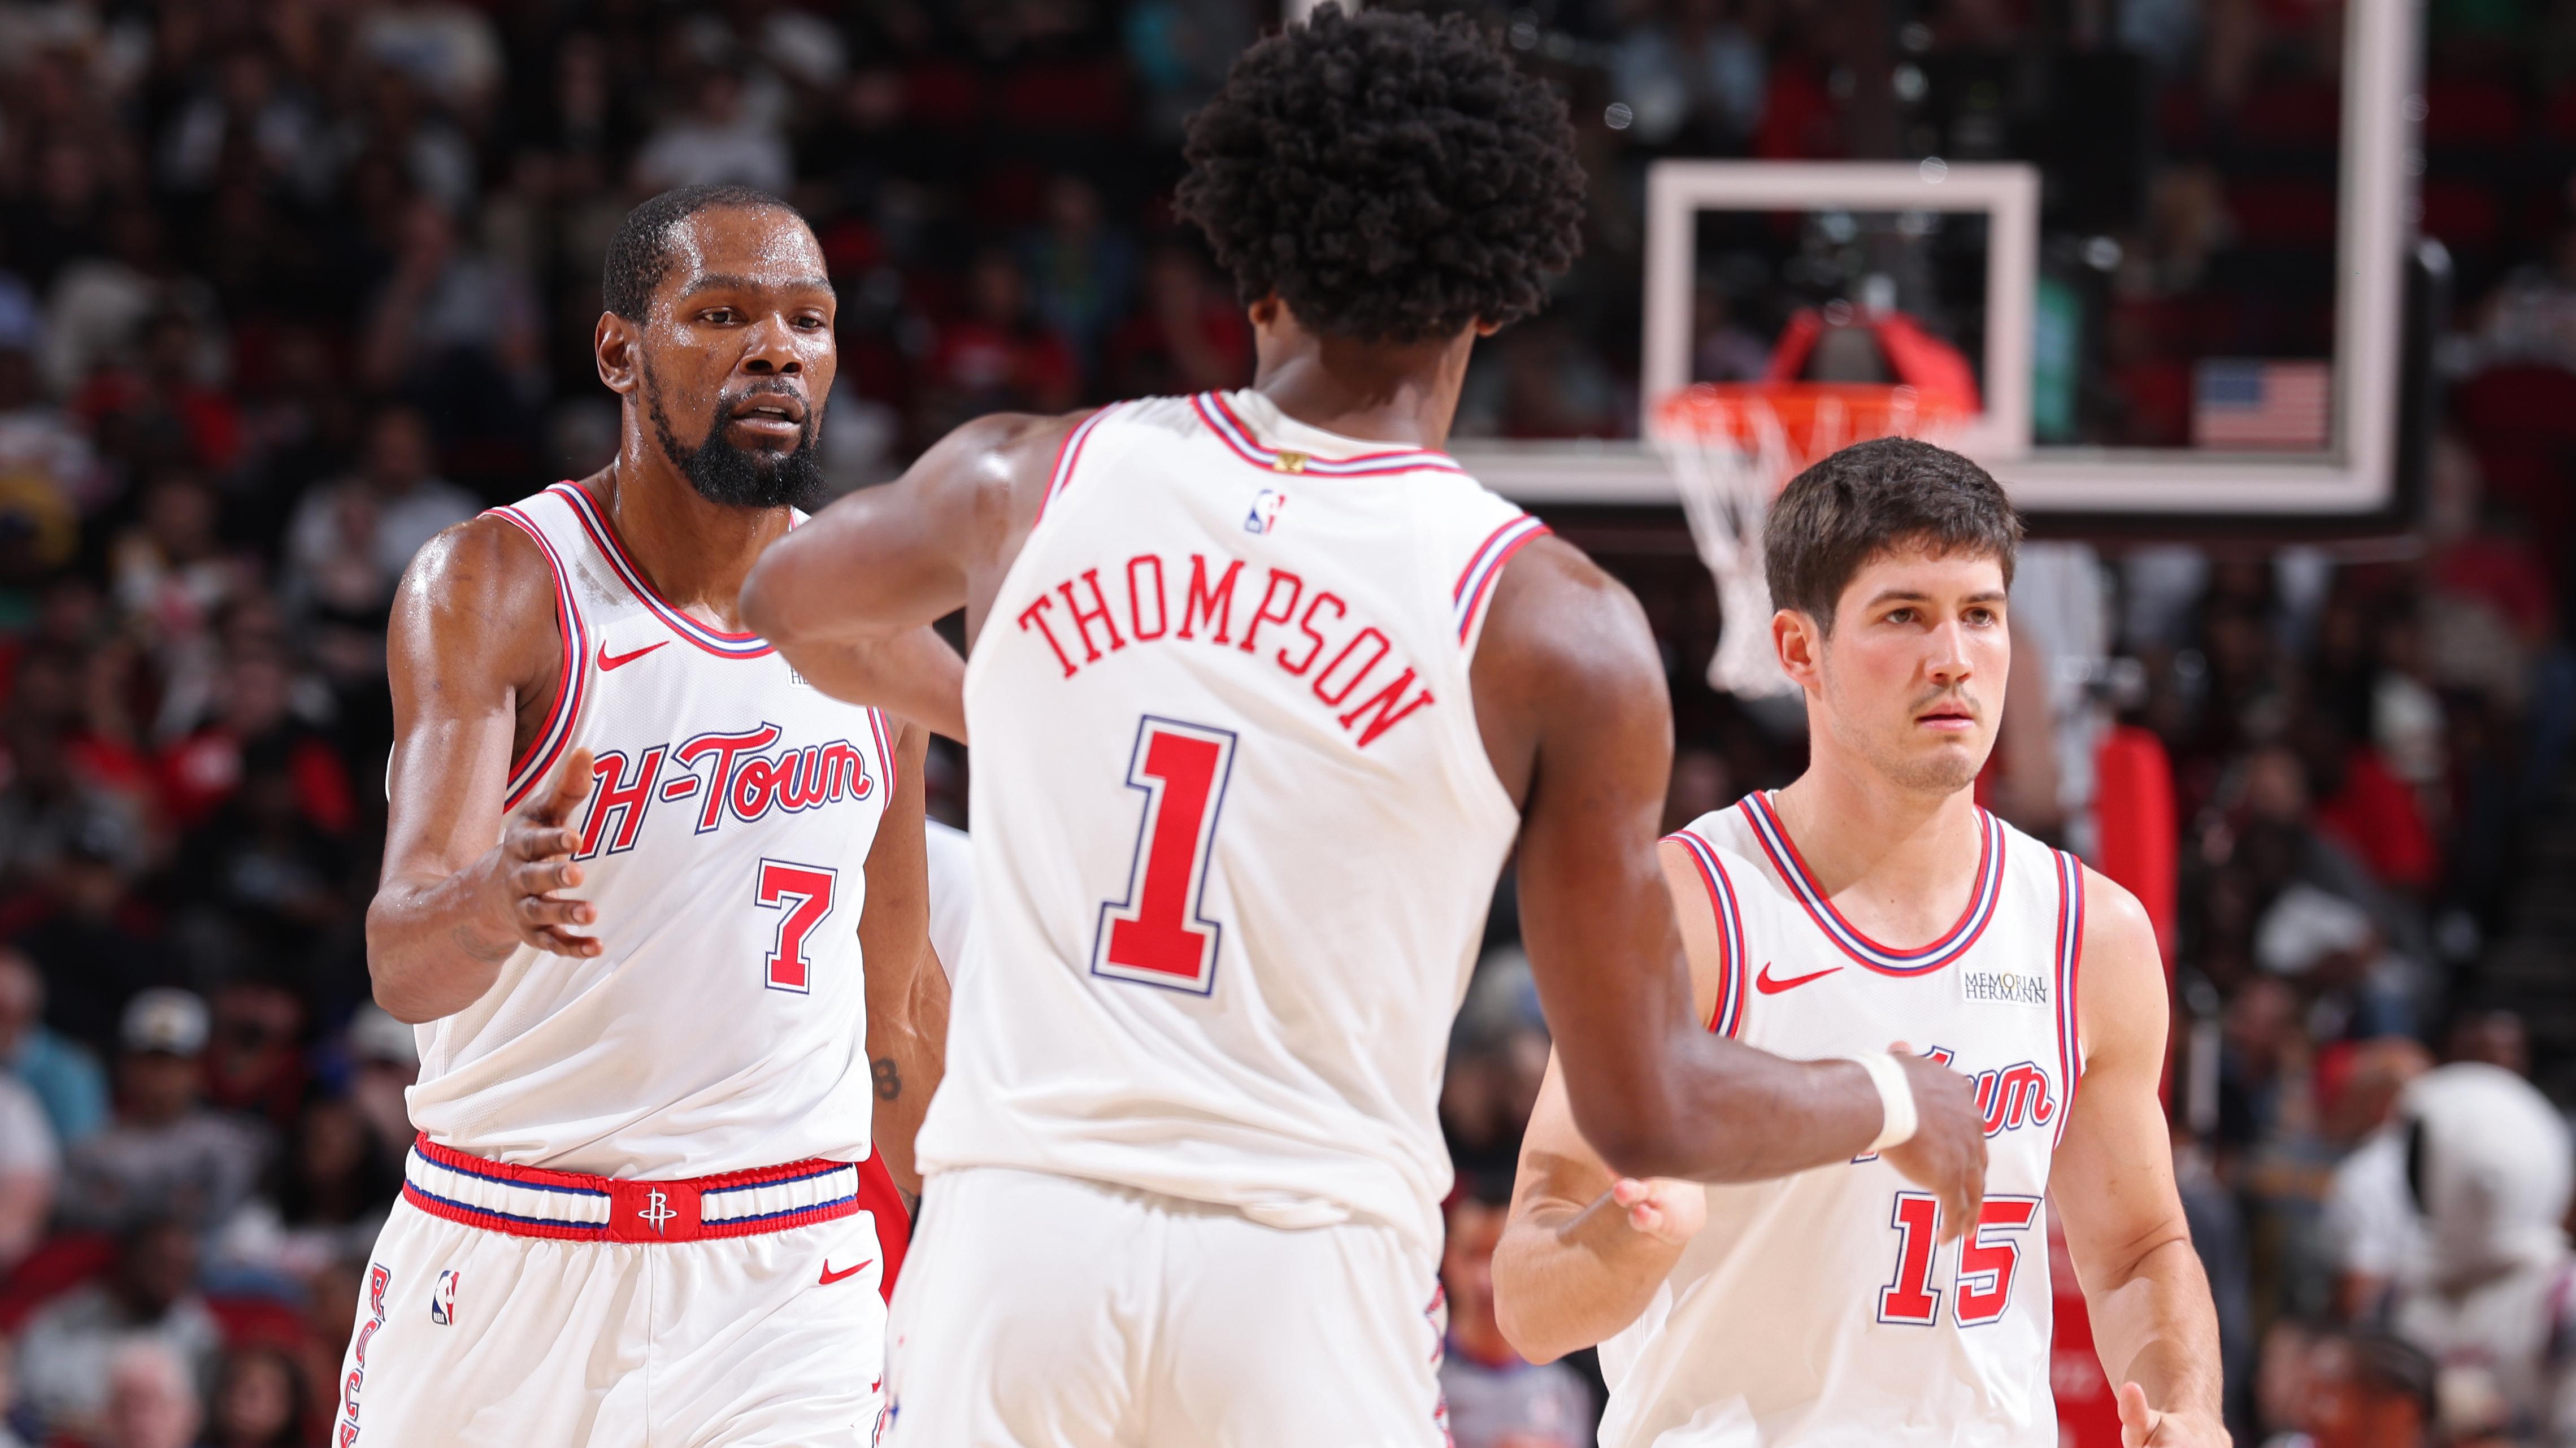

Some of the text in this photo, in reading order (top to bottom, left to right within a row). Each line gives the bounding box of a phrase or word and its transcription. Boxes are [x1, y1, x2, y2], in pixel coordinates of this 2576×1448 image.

[1018, 553, 1435, 749] THOMPSON
[570, 721, 874, 861] H-Town
[1091, 714, 1237, 998] 1
[754, 857, 838, 995] 7
[1965, 972, 2047, 990] MEMORIAL
[1966, 985, 2046, 1003] HERMANN
[433, 1312, 445, 1323] NBA
[1877, 1190, 2044, 1328] 15
